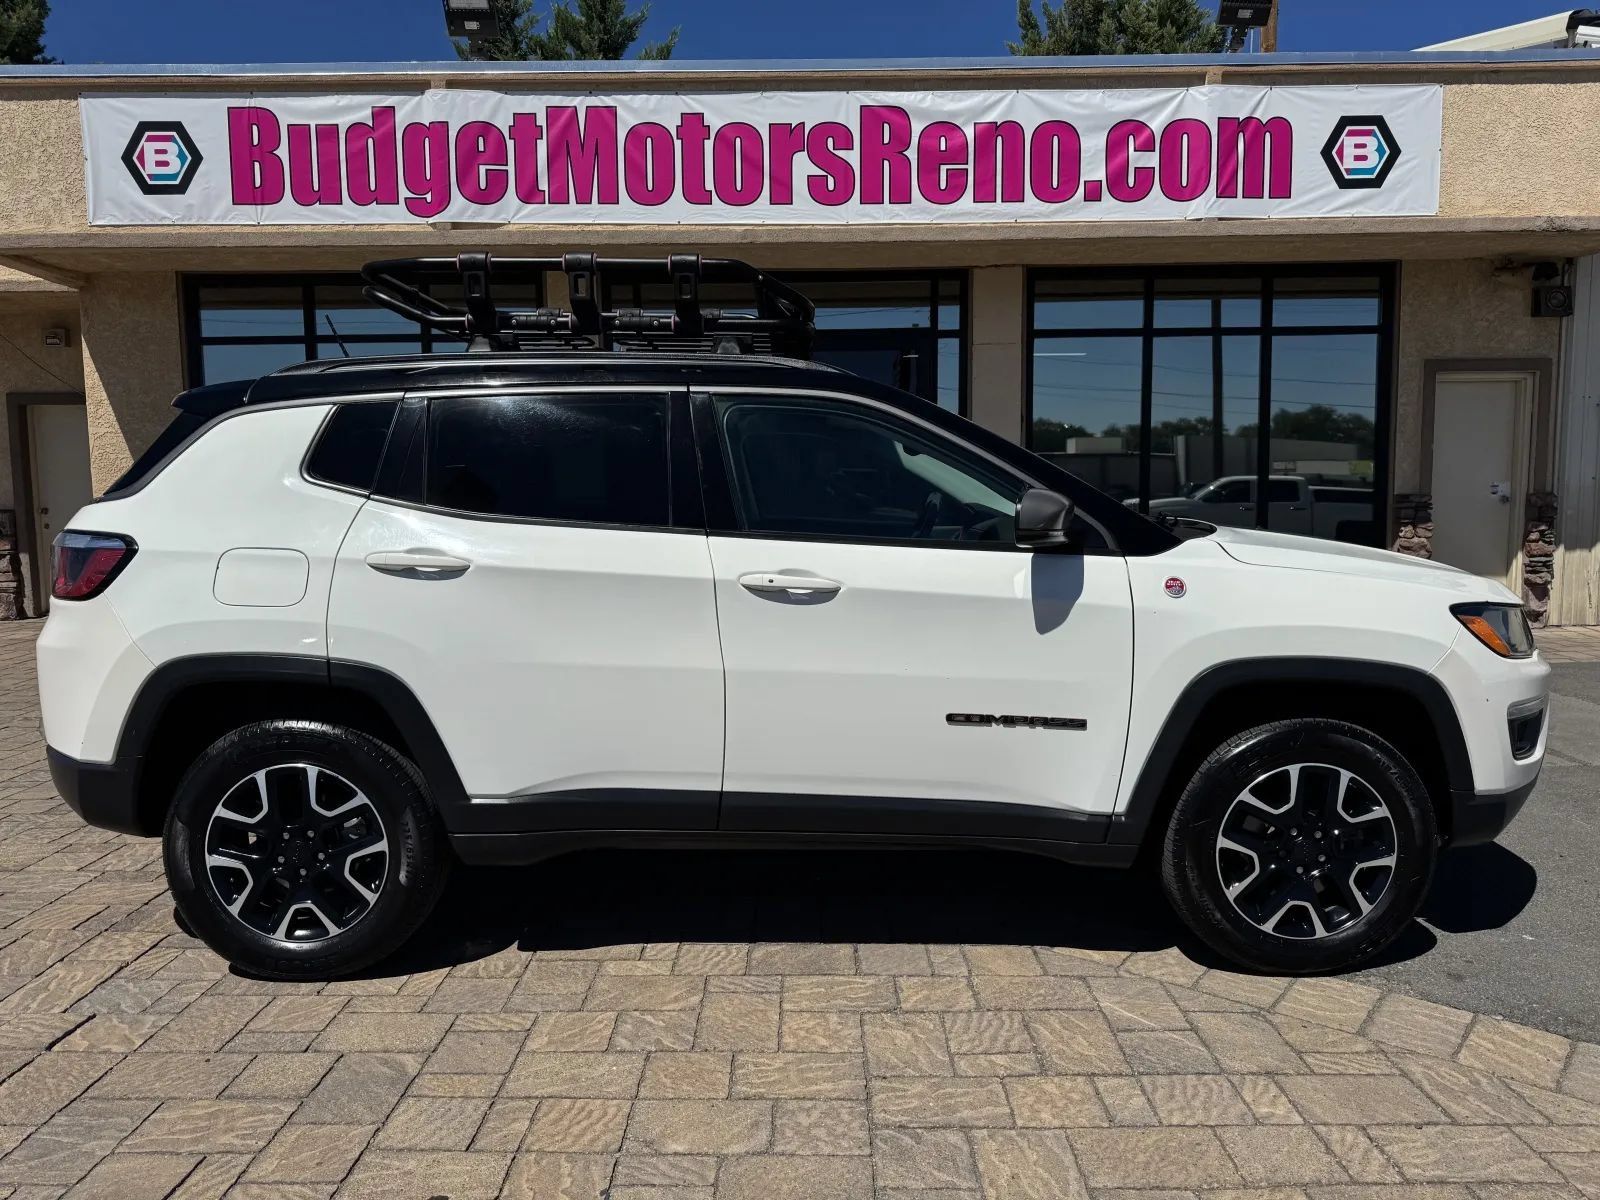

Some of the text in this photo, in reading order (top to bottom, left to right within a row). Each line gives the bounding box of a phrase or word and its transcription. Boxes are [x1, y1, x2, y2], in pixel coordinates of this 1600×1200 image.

[143, 141, 182, 174] B
[227, 105, 1293, 219] BudgetMotorsReno.com
[1342, 136, 1380, 169] B
[945, 712, 1088, 731] COMPASS
